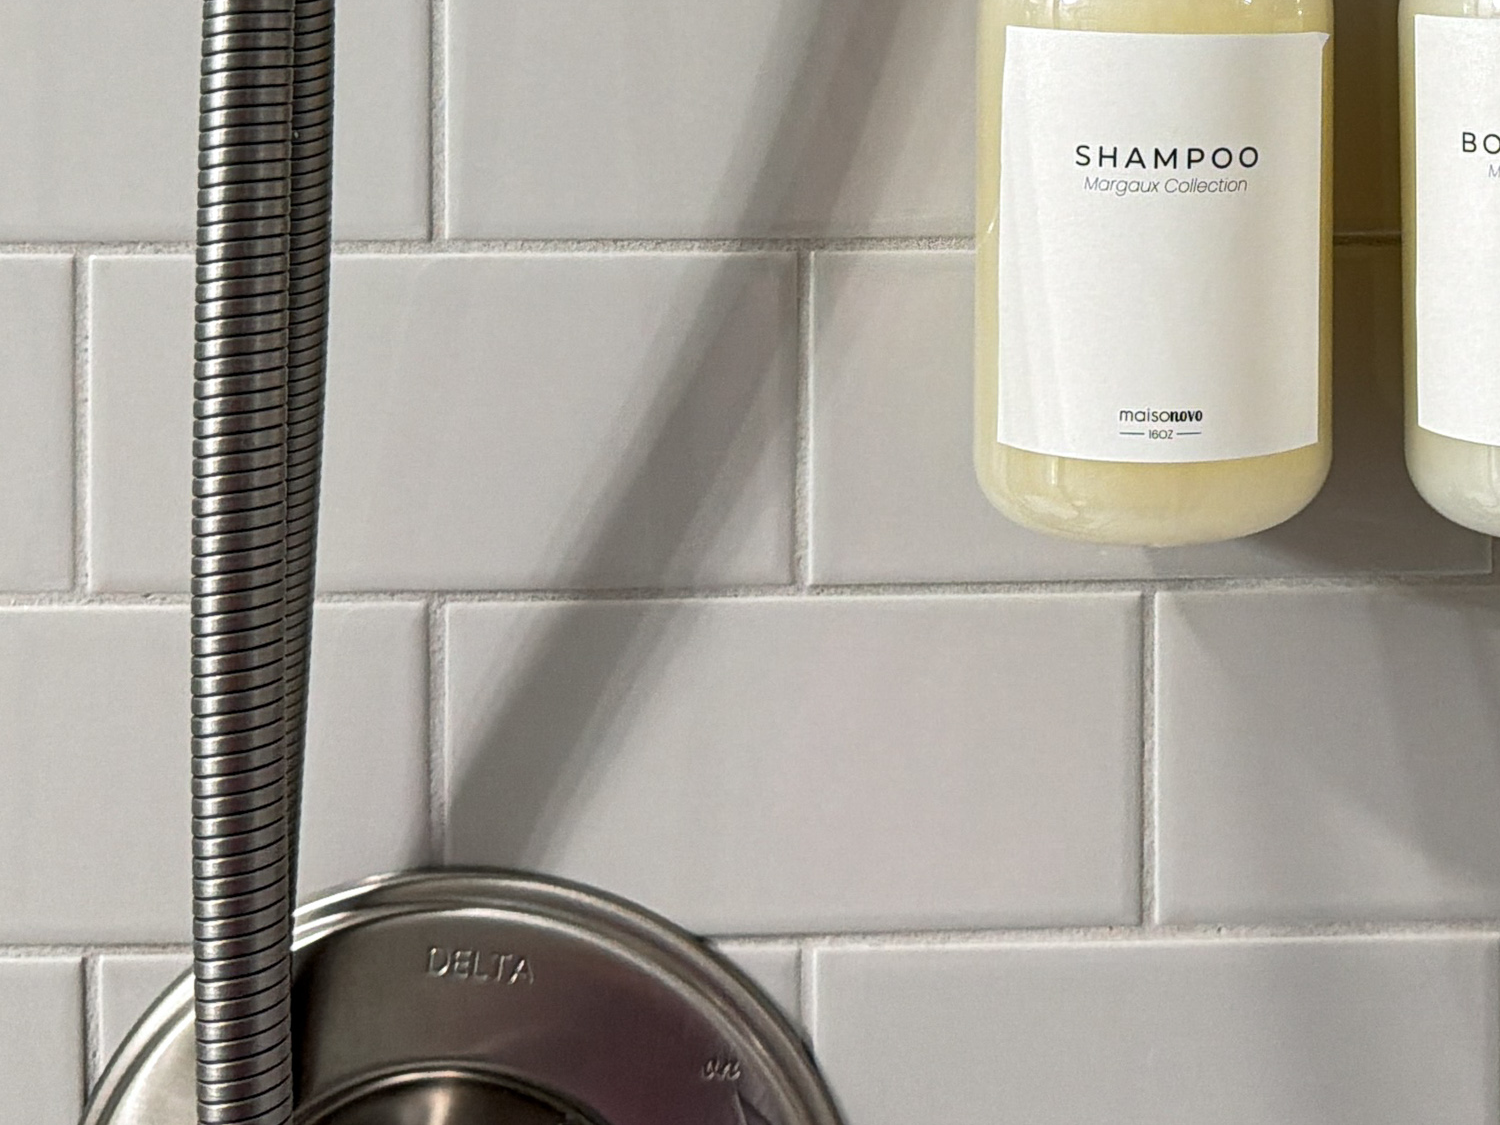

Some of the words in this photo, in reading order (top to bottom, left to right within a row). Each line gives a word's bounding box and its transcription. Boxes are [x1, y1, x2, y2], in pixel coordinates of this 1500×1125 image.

[1075, 145, 1258, 169] SHAMPOO
[1084, 176, 1160, 196] Margaux
[1164, 178, 1247, 193] Collection
[1119, 408, 1203, 422] maisonovo
[427, 947, 535, 985] DELTA
